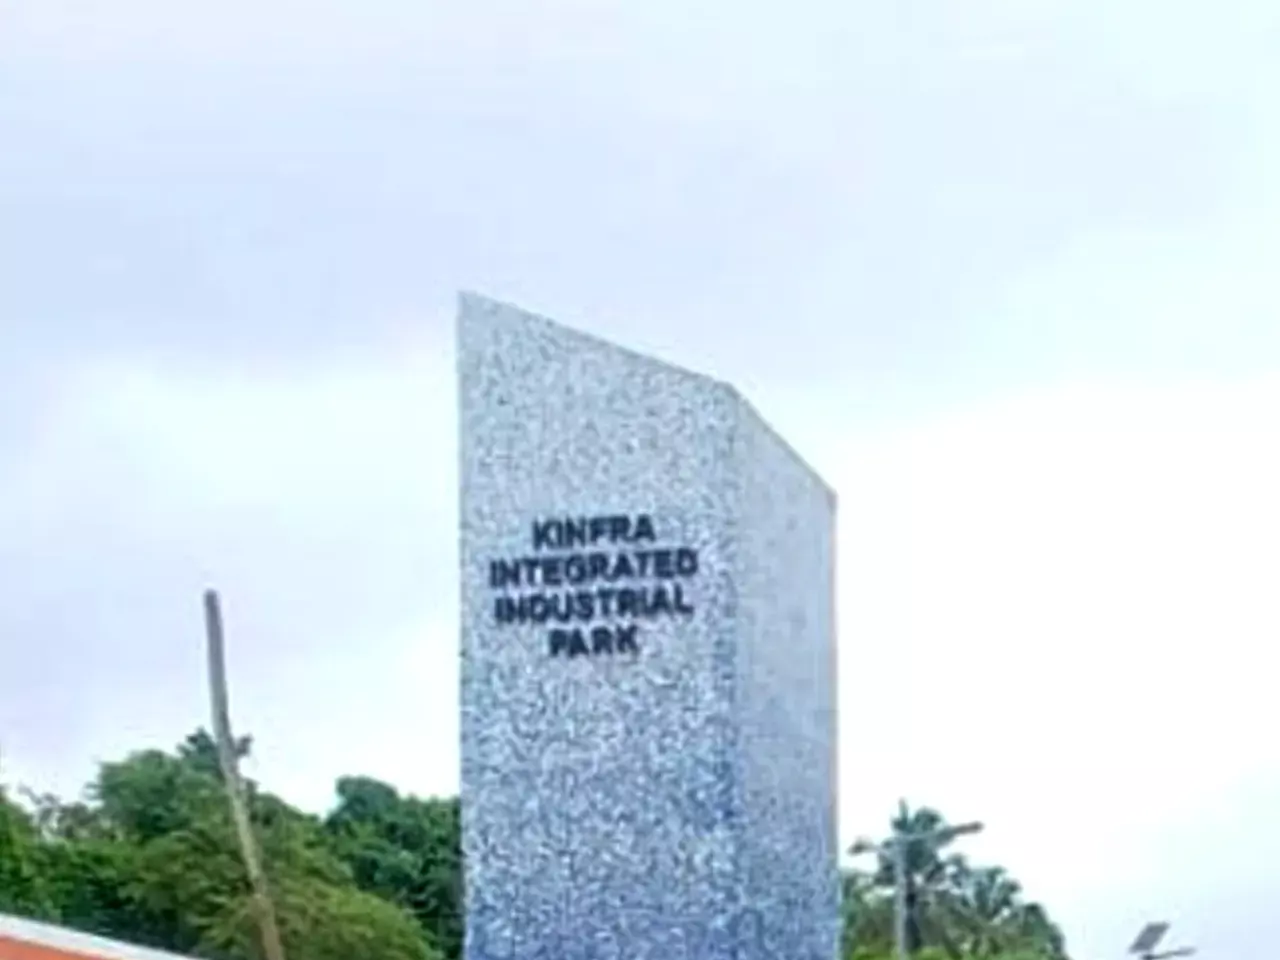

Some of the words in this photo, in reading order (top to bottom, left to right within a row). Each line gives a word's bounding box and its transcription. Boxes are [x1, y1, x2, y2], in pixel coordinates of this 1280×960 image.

[532, 514, 656, 550] KINFRA
[489, 547, 699, 589] INTEGRATED
[494, 583, 695, 624] INDUSTRIAL
[549, 624, 640, 658] PARK
